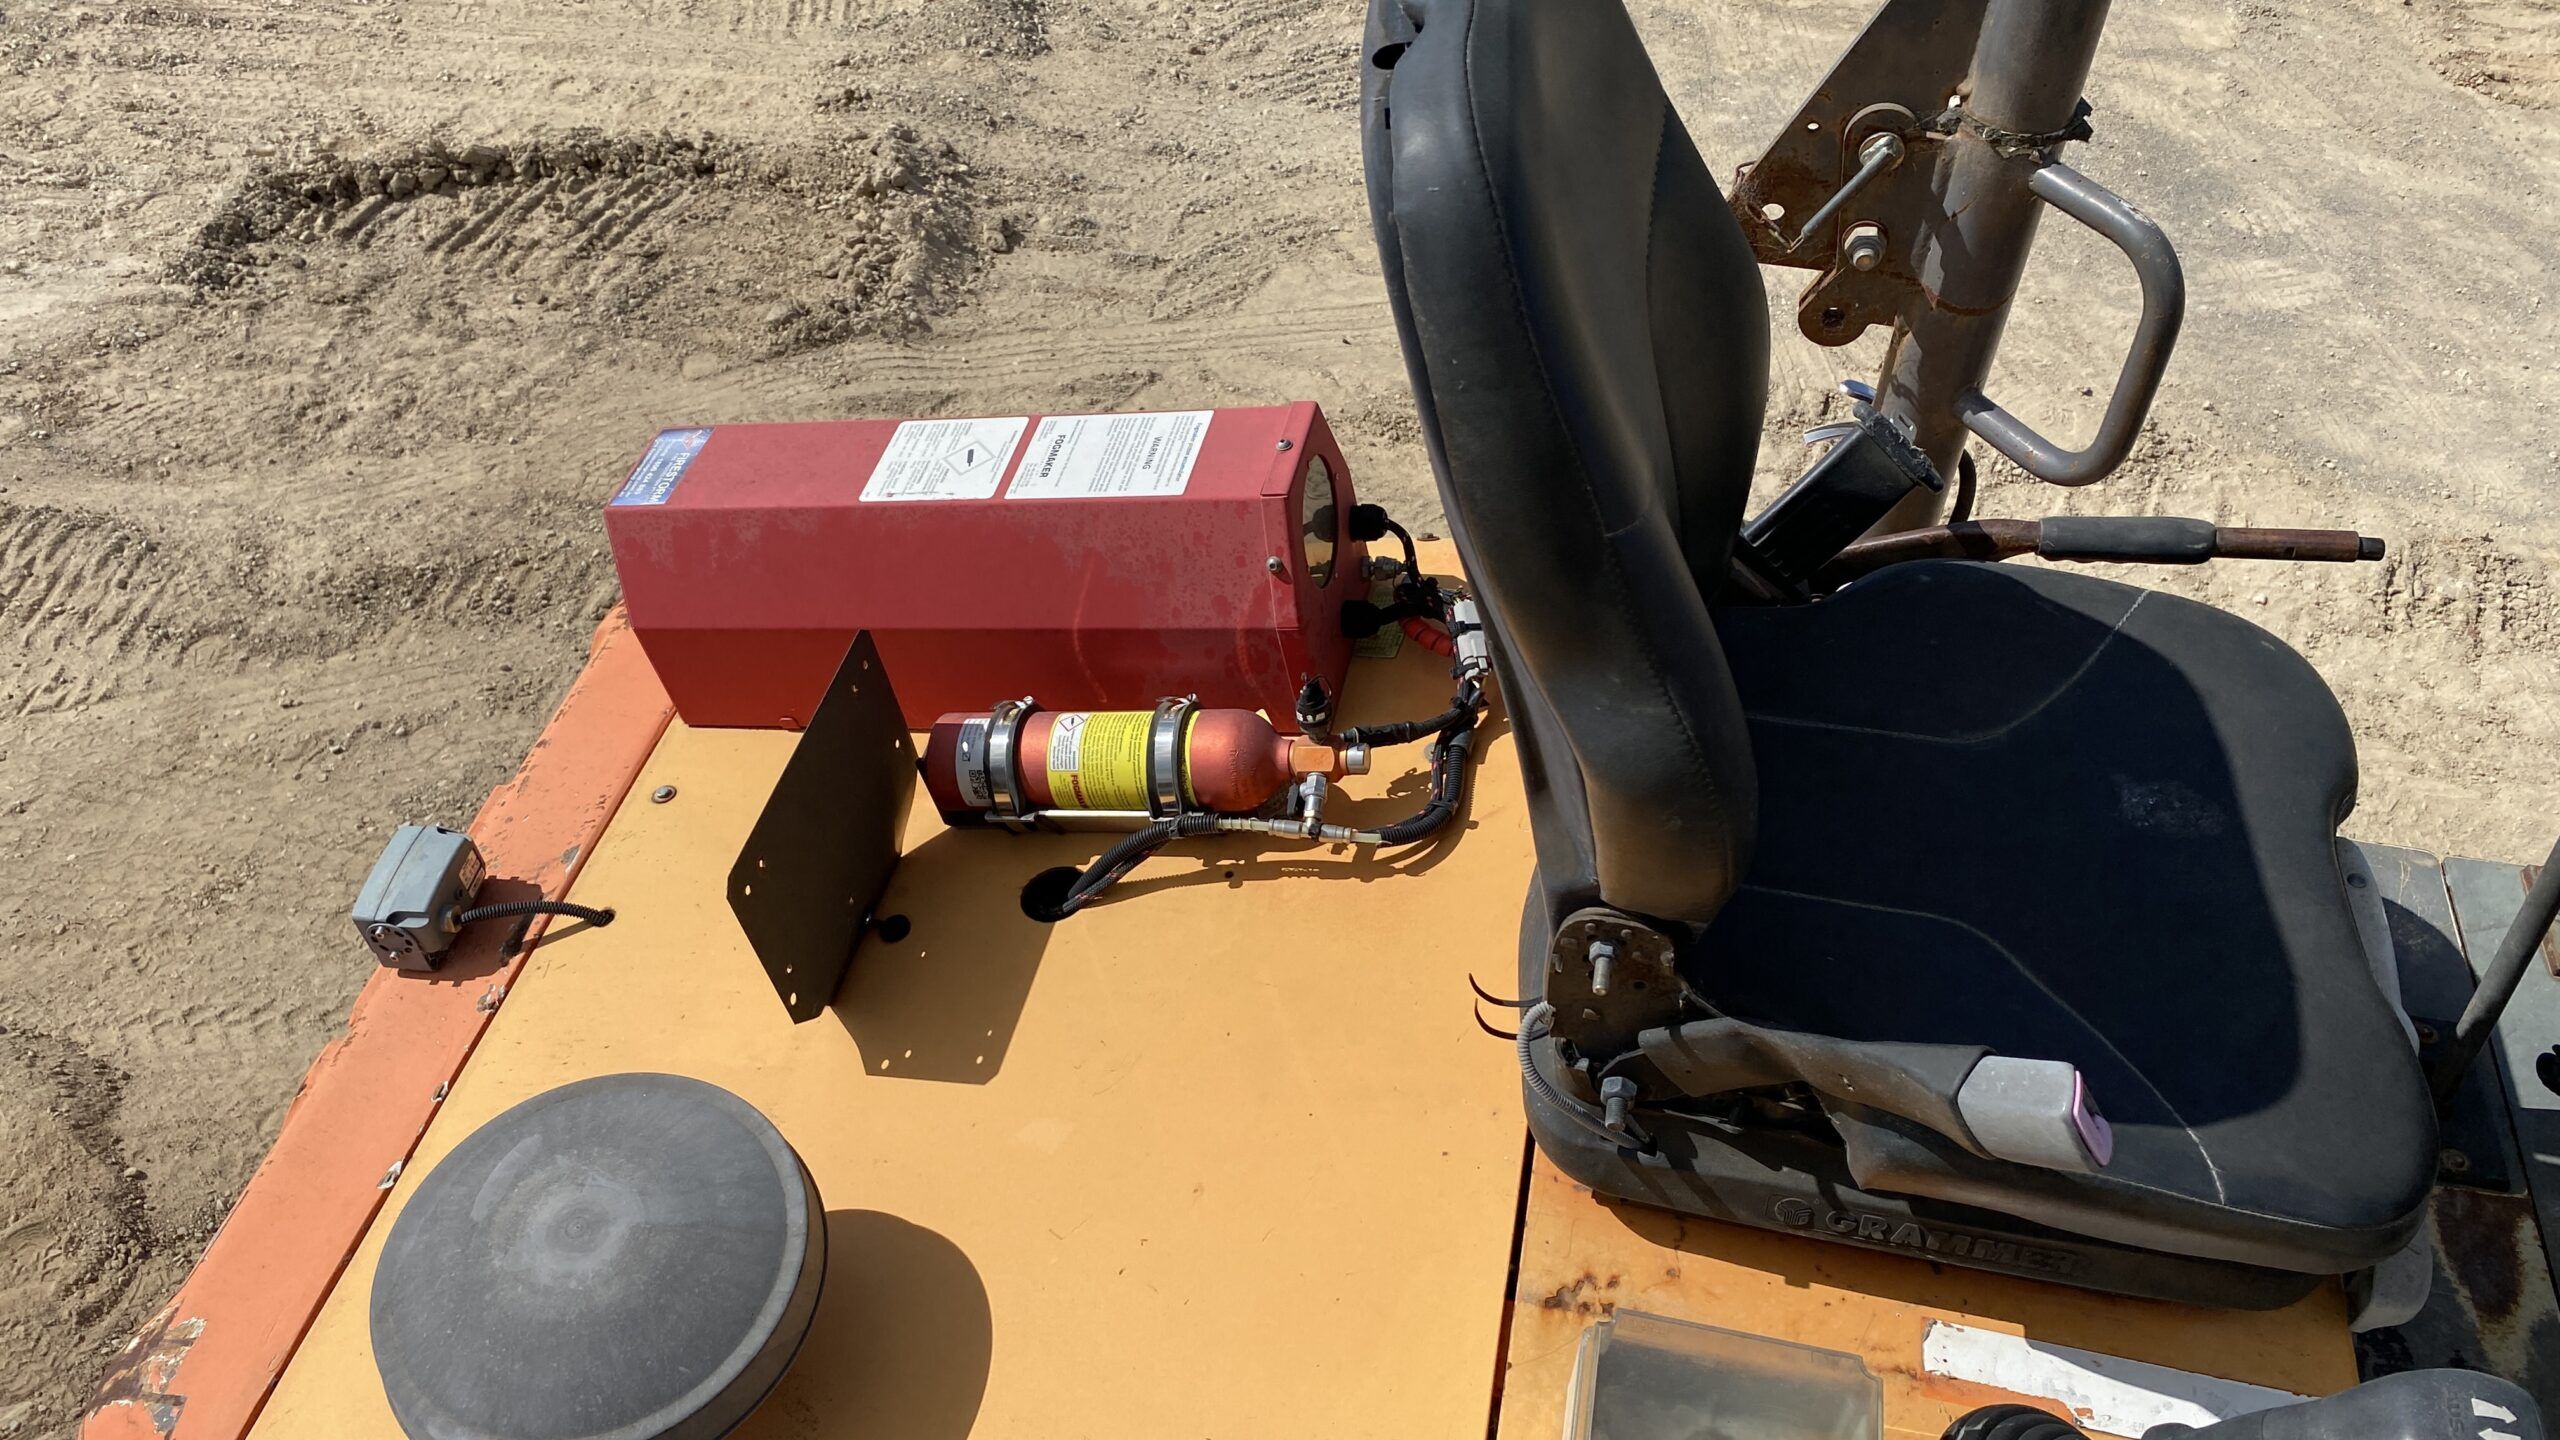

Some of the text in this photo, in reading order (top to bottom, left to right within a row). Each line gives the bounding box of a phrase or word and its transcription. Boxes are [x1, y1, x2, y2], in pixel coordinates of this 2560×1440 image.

[1039, 434, 1067, 478] FOGMAKER
[1142, 436, 1163, 470] WARNING
[648, 452, 691, 503] FIRESTORM
